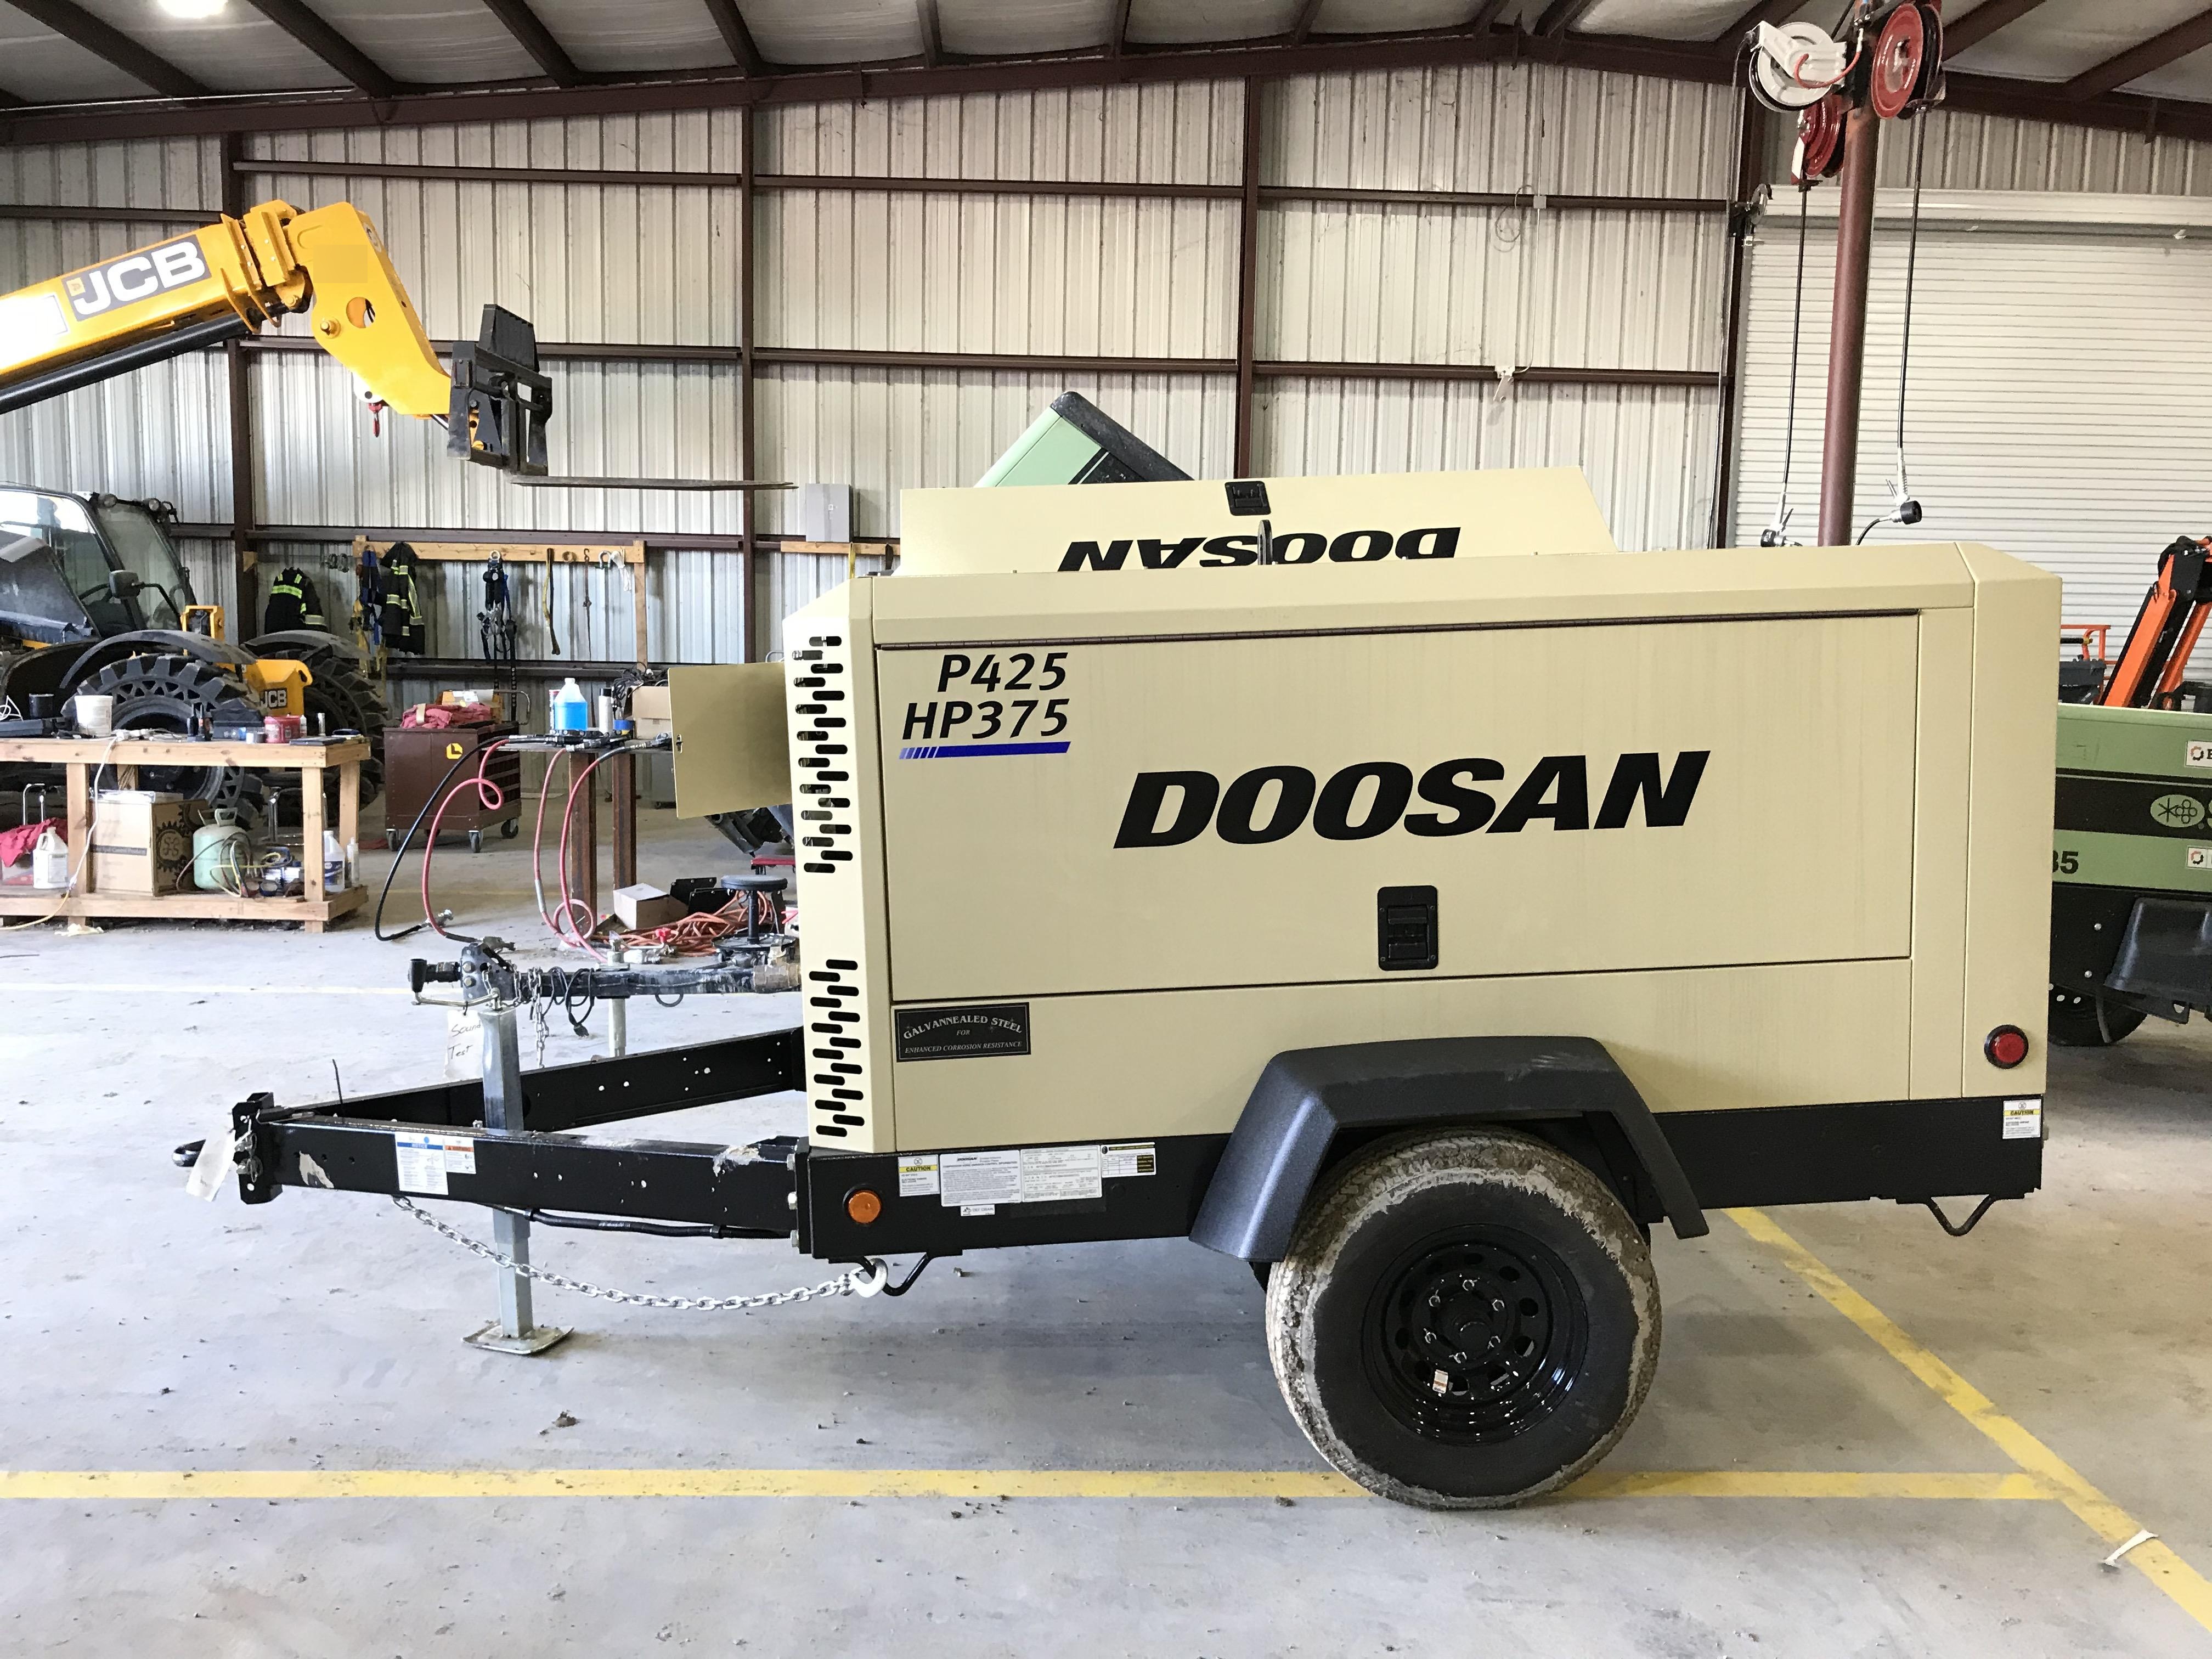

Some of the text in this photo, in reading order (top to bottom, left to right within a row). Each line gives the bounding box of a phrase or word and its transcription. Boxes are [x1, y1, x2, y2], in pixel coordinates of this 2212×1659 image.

[73, 241, 205, 315] JCB
[1057, 527, 1461, 572] DOOSAN
[937, 652, 1069, 693] P425
[261, 690, 287, 708] JCB
[902, 698, 1070, 740] HP375
[1113, 750, 1711, 849] DOOSAN
[451, 1020, 481, 1037] Sound
[903, 1015, 1023, 1039] GALVANNEALED STEEL
[448, 1043, 473, 1059] Test
[905, 1045, 942, 1053] ENHANCED
